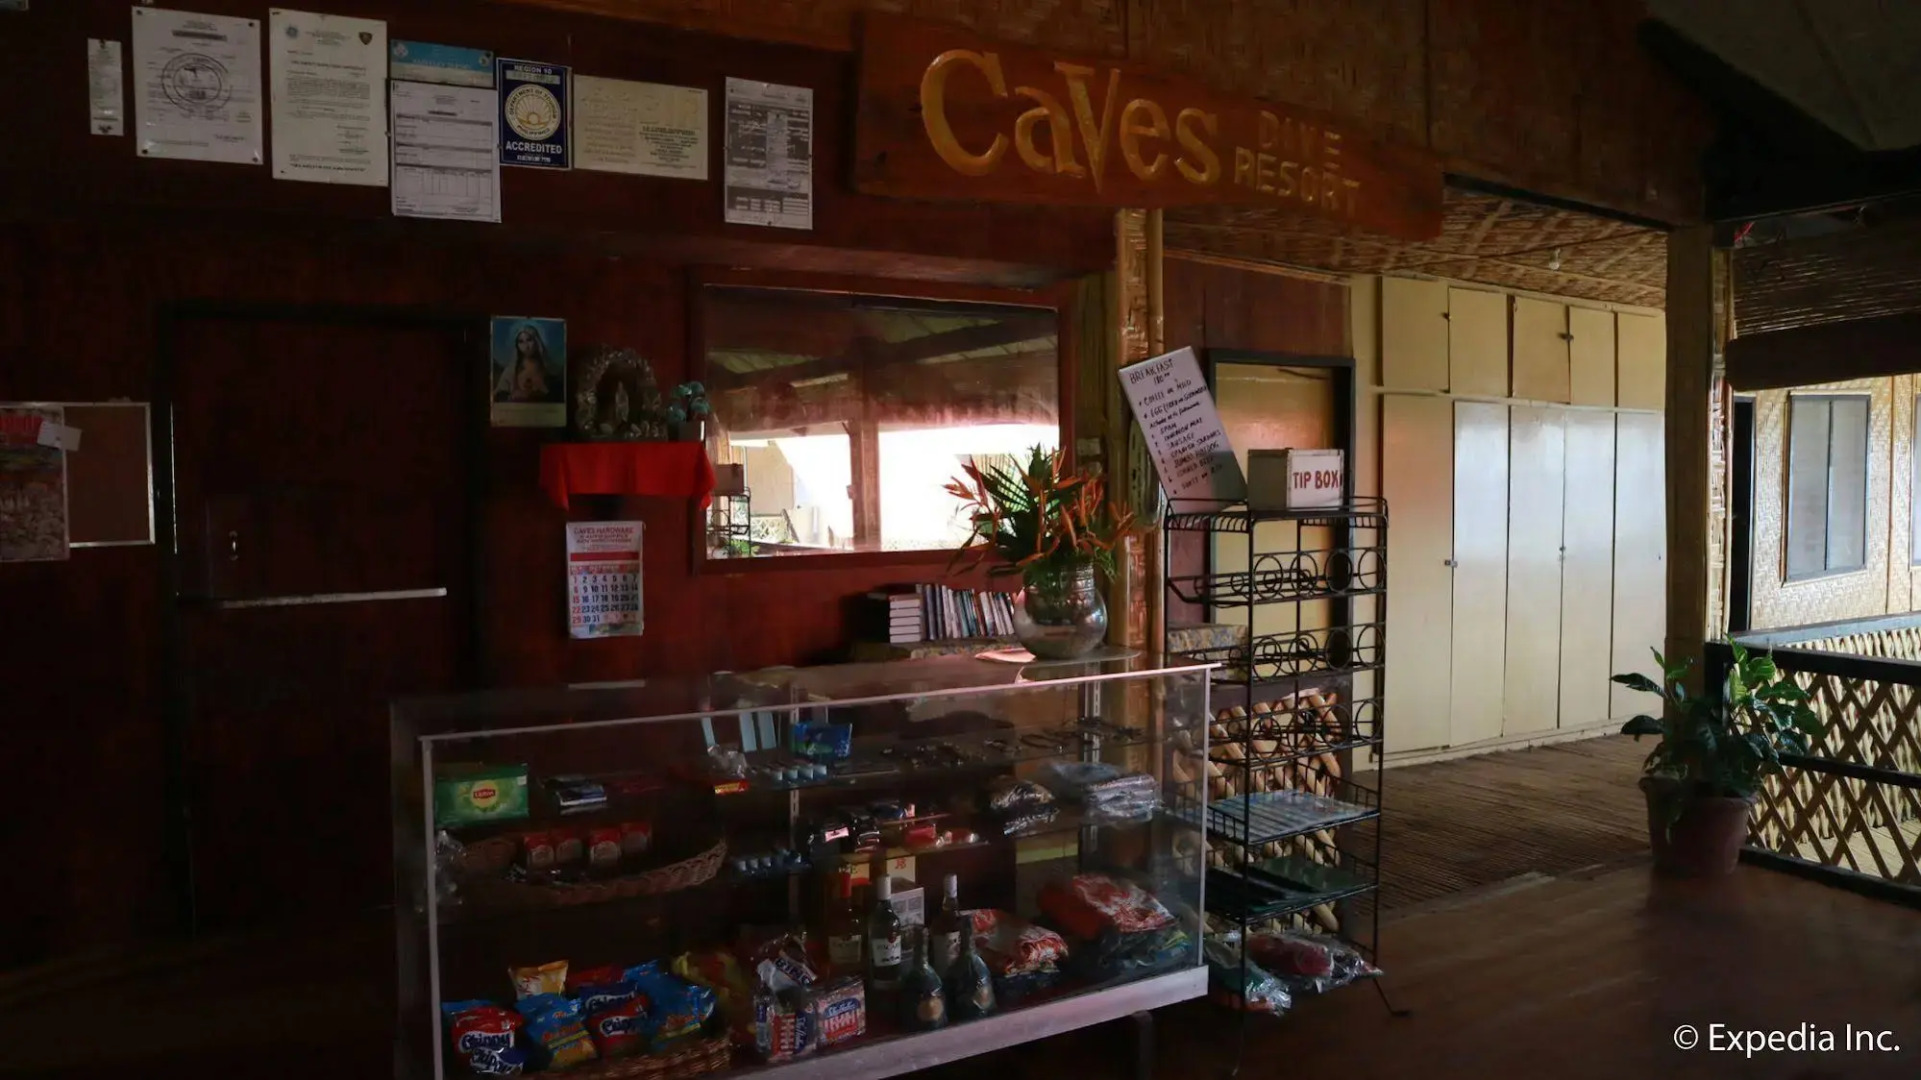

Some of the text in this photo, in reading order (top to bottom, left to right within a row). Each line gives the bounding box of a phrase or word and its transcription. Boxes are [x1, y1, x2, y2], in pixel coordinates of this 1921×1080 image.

[514, 64, 542, 74] REGION
[509, 88, 534, 116] DEPARTMENT
[505, 140, 563, 155] ACCREDITED
[1234, 146, 1361, 218] RESORT
[1129, 358, 1174, 385] BREAKFAST
[1160, 423, 1177, 434] SPAM
[1292, 470, 1339, 489] TIP BOX
[461, 1032, 511, 1049] Chippy
